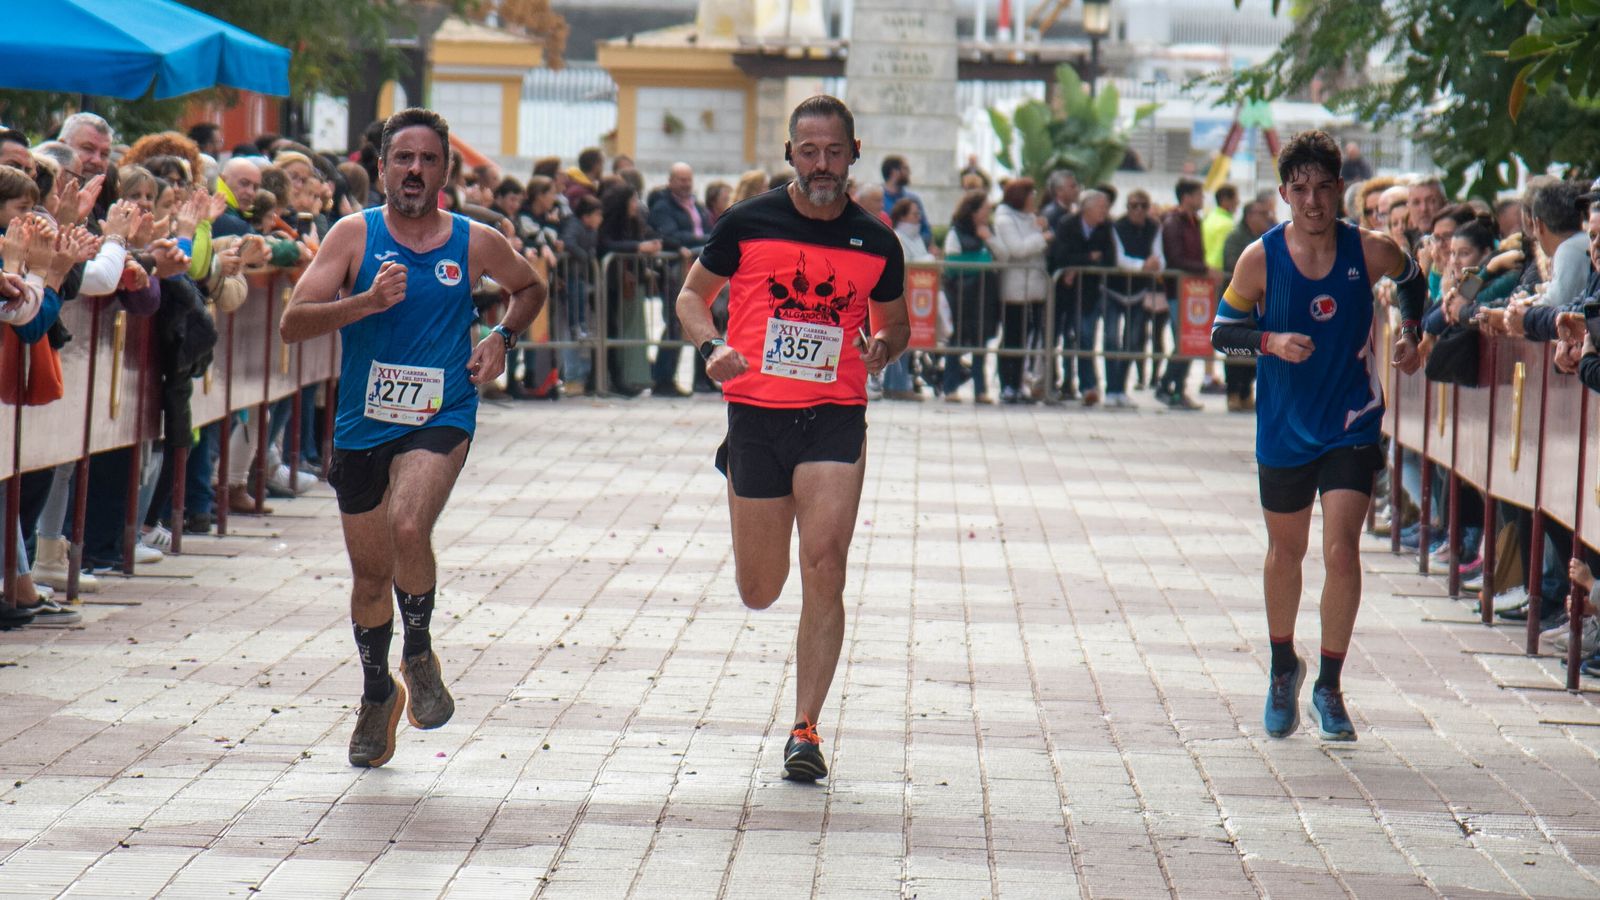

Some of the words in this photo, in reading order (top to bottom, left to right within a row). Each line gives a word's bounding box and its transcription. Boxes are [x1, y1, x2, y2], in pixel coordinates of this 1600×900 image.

[779, 325, 804, 337] XIV
[803, 327, 827, 335] CARRERA
[814, 335, 840, 343] ESTRECHO
[782, 336, 822, 362] 357
[378, 367, 402, 380] XIV
[381, 380, 423, 405] 277
